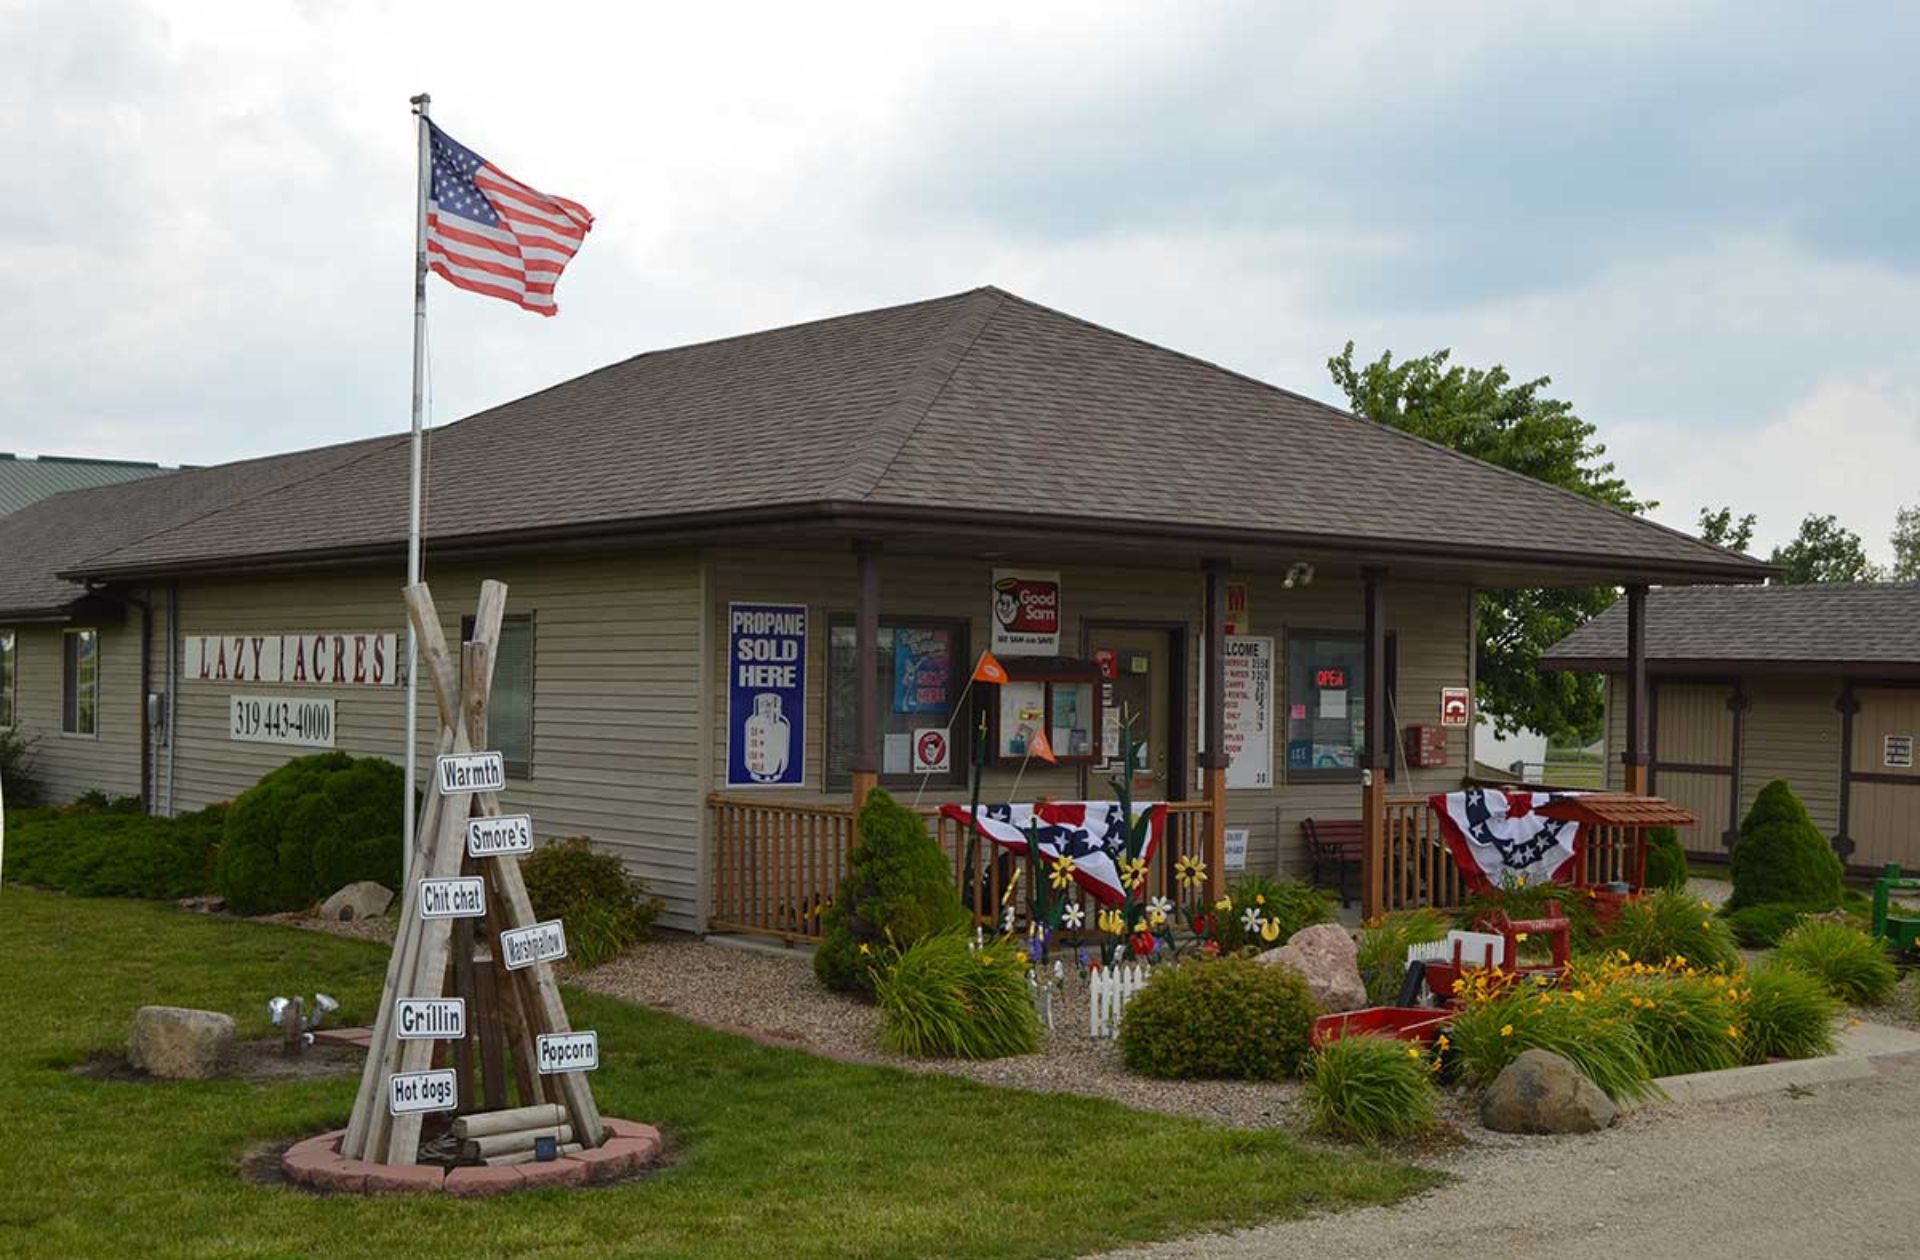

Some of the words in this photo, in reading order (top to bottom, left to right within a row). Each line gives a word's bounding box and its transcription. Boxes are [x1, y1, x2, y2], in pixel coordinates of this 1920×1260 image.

[1020, 589, 1056, 606] Good
[732, 611, 804, 636] PROPANE
[1025, 604, 1055, 621] Sam
[199, 637, 264, 681] LAZY
[293, 634, 386, 684] ACRES
[737, 638, 798, 662] SOLD
[1223, 642, 1260, 657] LCOME
[738, 664, 797, 688] HERE
[1316, 670, 1344, 687] OPEN
[234, 701, 260, 736] 319
[263, 702, 331, 742] 443-4000
[442, 757, 500, 788] Warmth
[472, 820, 528, 850] Smore's
[424, 884, 451, 912] Chit
[452, 882, 481, 911] chat
[402, 1003, 460, 1032] Grillin
[542, 1040, 594, 1065] Popcorn
[394, 1079, 418, 1103] Hot
[421, 1076, 452, 1104] dogs
